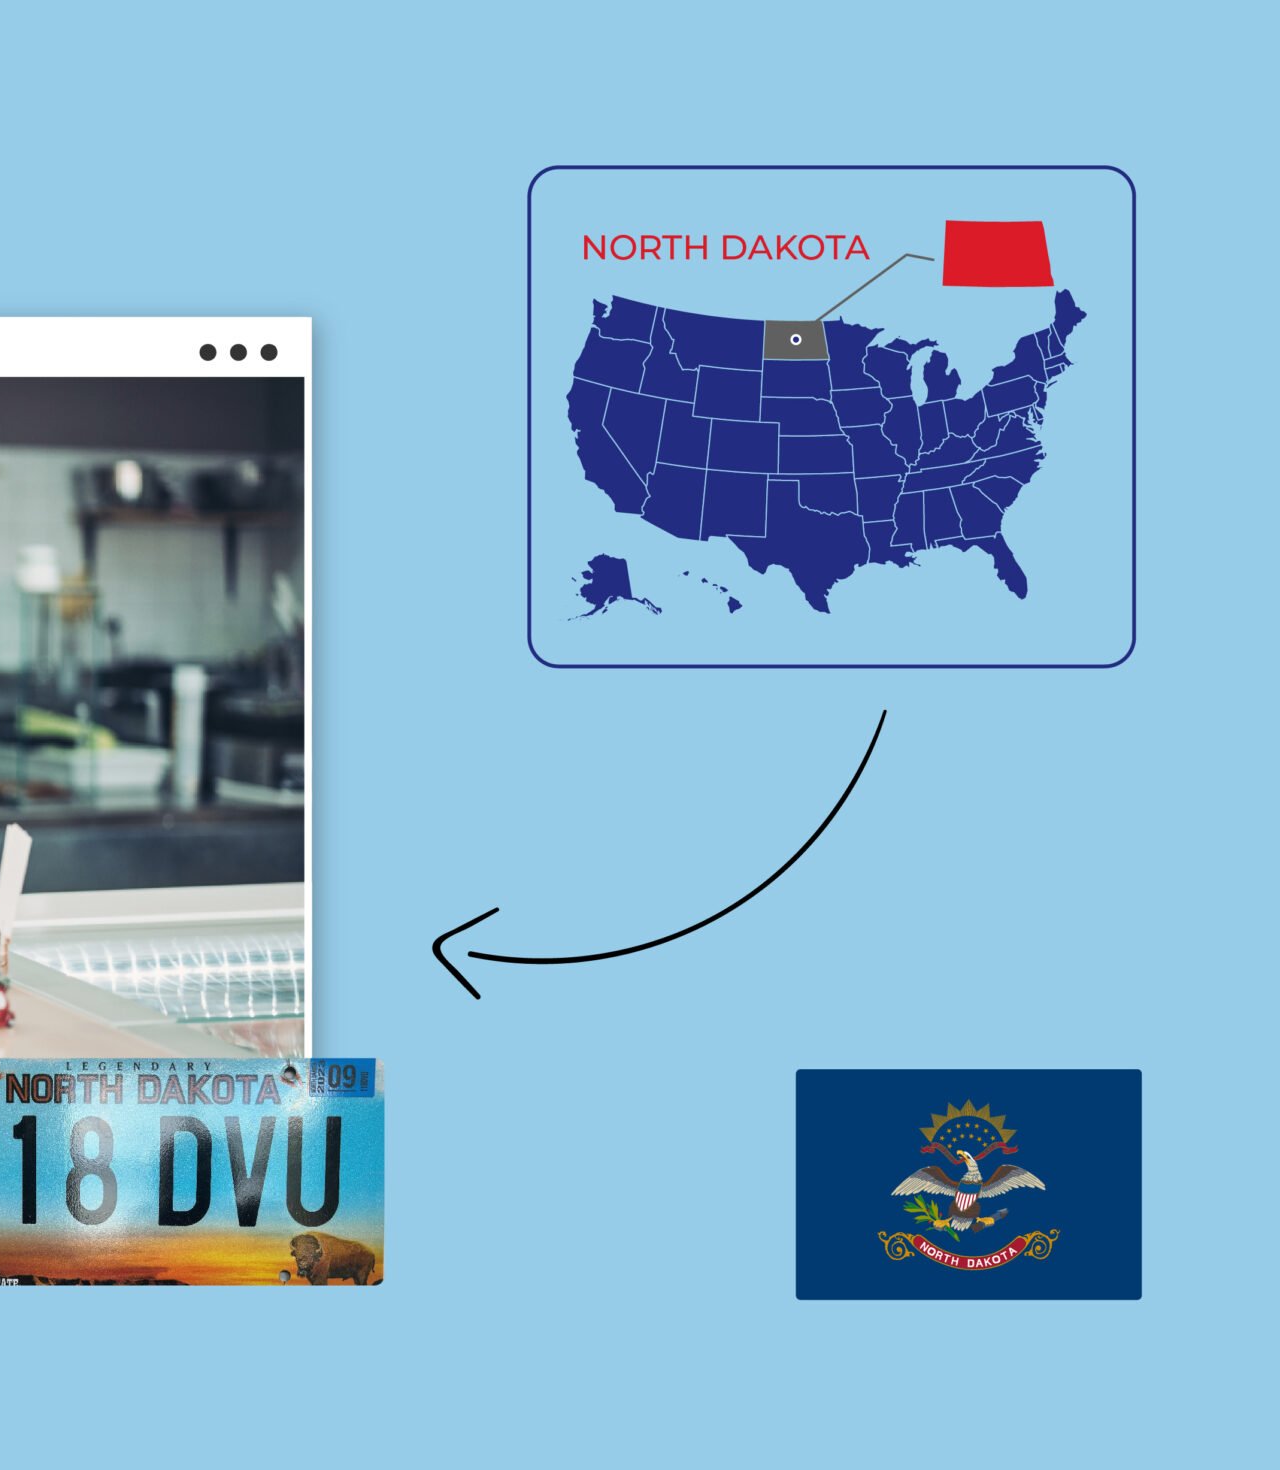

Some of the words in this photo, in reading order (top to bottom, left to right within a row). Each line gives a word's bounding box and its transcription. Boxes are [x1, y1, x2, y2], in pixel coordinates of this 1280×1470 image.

[65, 1061, 212, 1071] LEGENDARY
[328, 1064, 356, 1089] 09
[5, 1073, 124, 1105] NORTH
[137, 1074, 282, 1106] DAKOTA
[157, 1115, 341, 1227] DVU
[920, 1241, 960, 1267] NORTH
[967, 1247, 1018, 1268] DAKOTA
